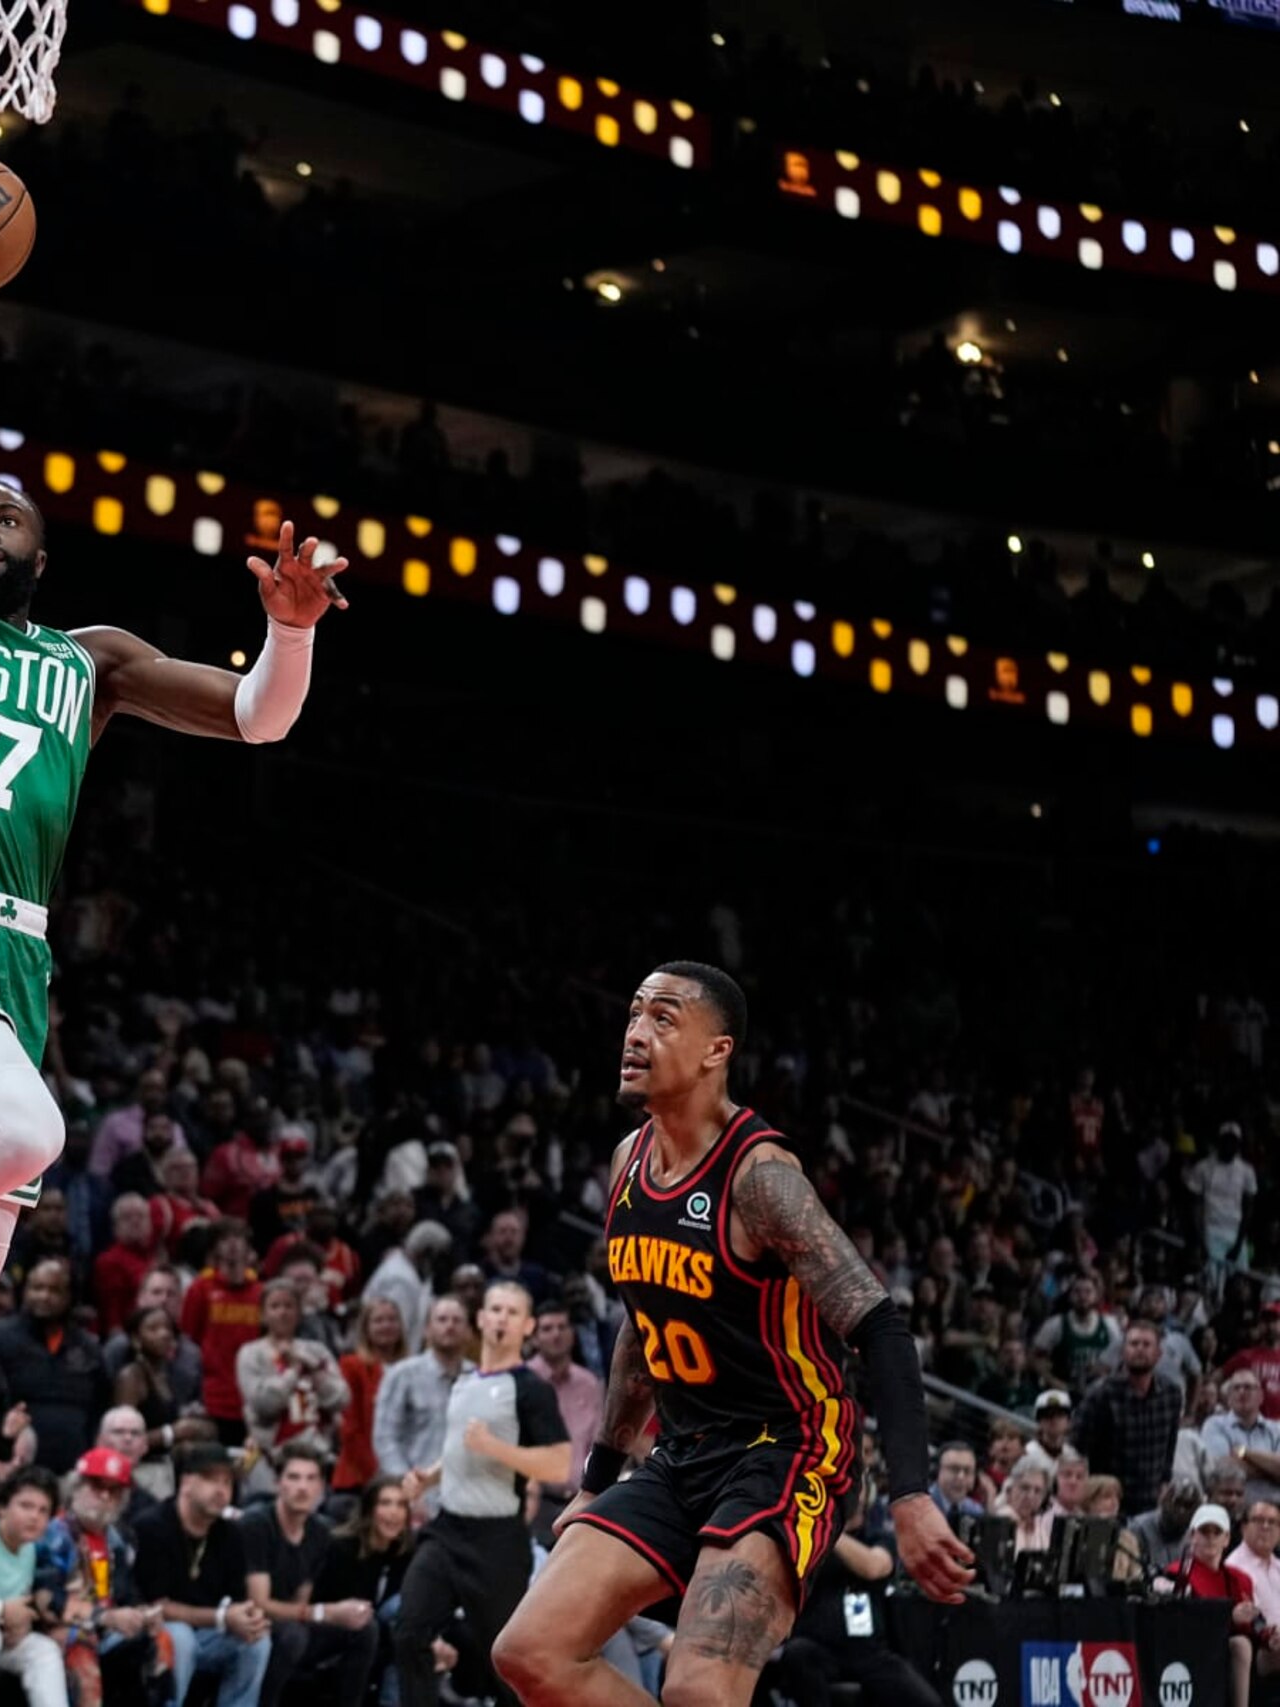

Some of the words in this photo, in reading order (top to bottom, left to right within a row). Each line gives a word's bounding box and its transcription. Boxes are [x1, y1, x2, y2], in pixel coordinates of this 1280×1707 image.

[607, 1235, 715, 1301] HAWKS
[635, 1308, 719, 1386] 20
[955, 1679, 999, 1702] TNT
[1030, 1657, 1061, 1707] NBA
[1089, 1672, 1134, 1698] TNT
[1160, 1681, 1193, 1702] TNT
